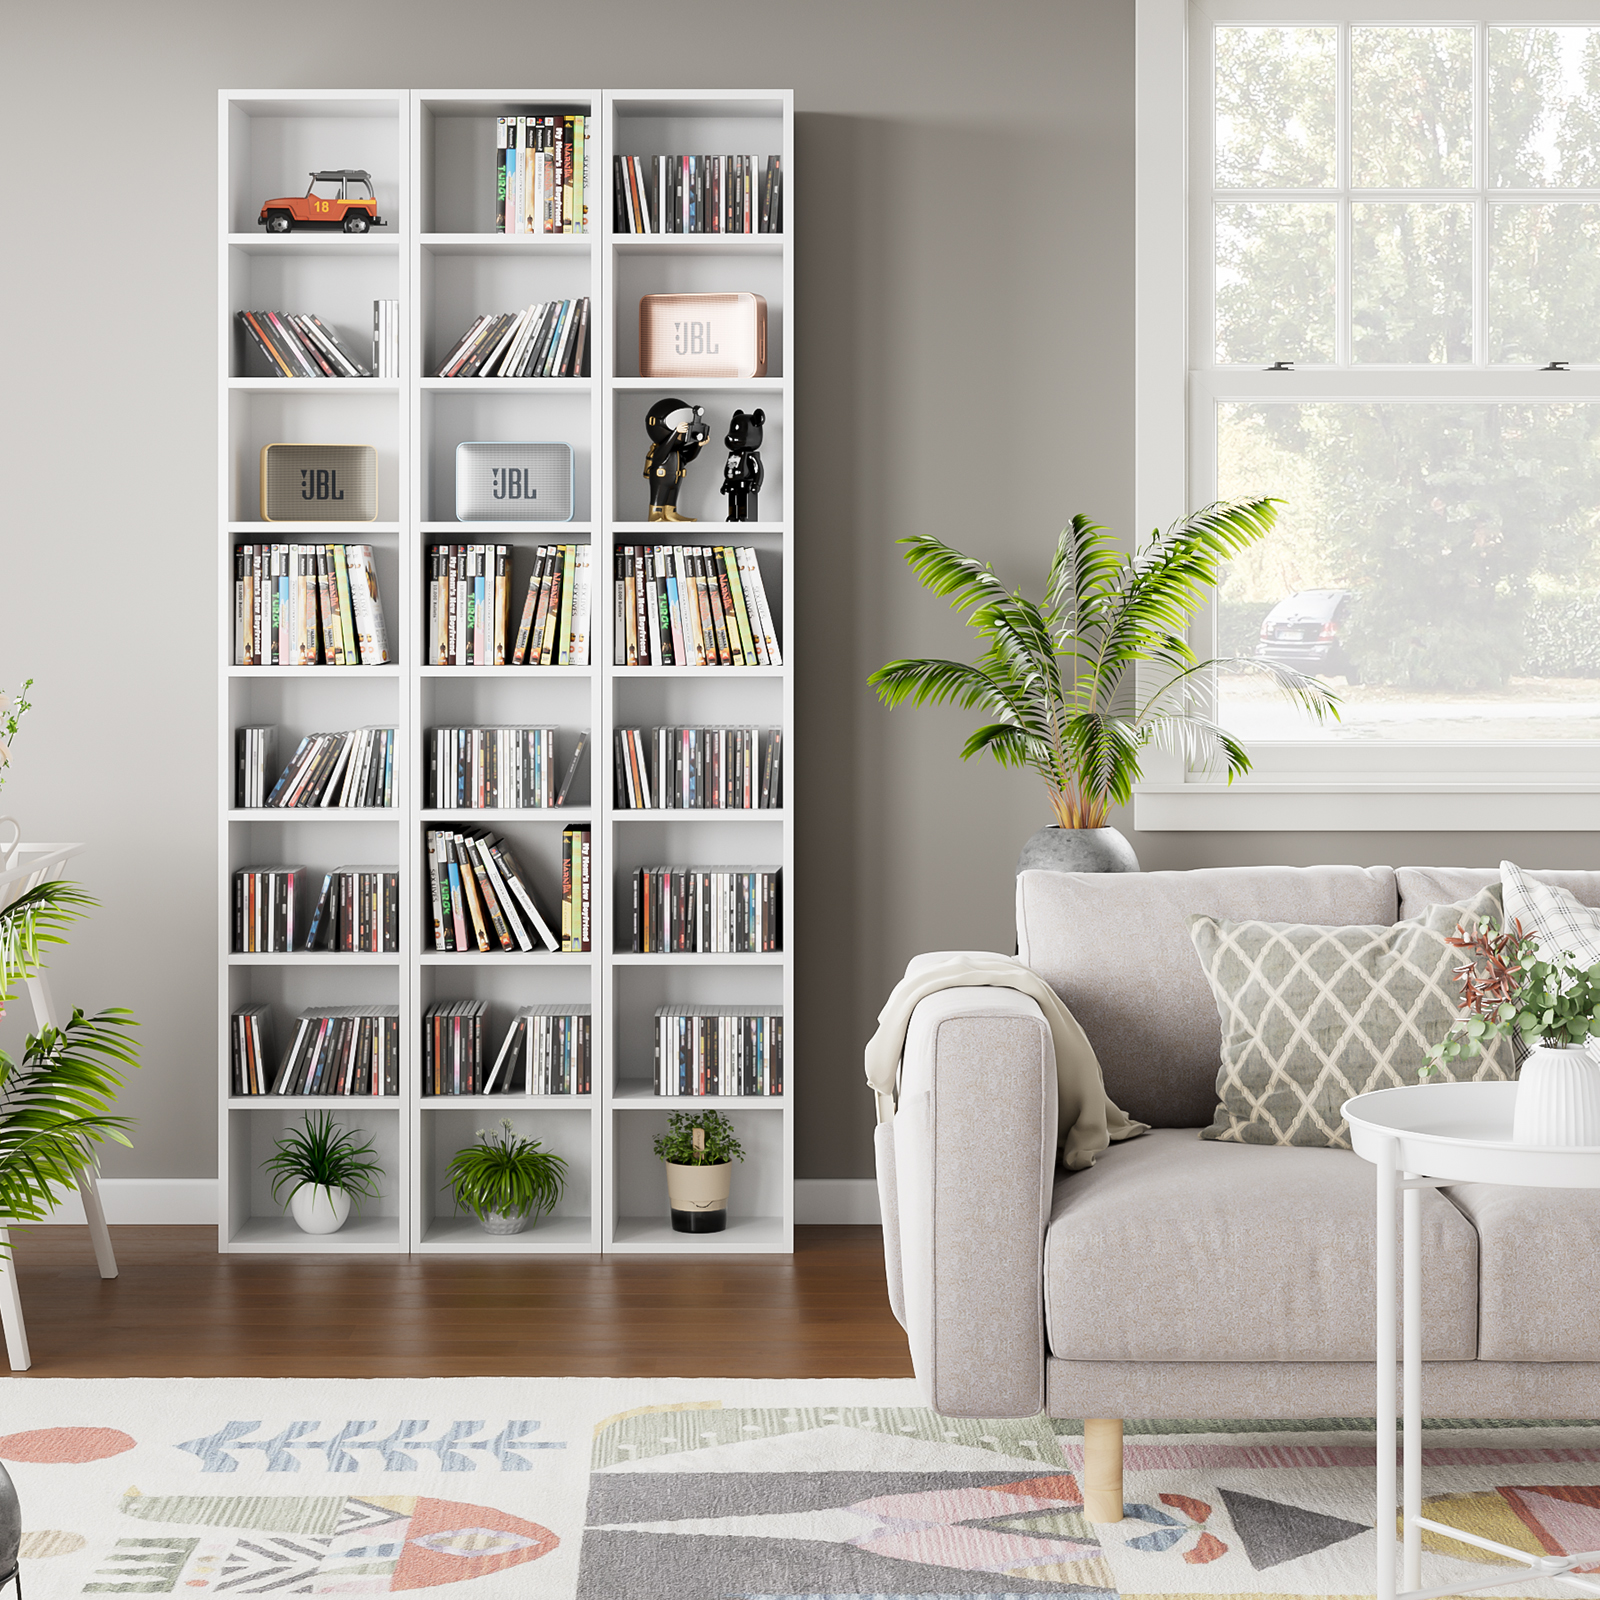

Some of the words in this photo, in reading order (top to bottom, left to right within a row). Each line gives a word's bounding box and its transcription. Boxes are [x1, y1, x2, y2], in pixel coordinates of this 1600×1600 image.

[554, 127, 563, 140] My
[555, 168, 563, 185] New
[313, 201, 330, 213] 18
[554, 186, 563, 227] Boyfriend
[674, 321, 720, 356] JBL
[300, 469, 344, 500] JBL
[492, 468, 537, 500] JBL
[253, 556, 261, 568] My
[448, 557, 456, 569] My
[635, 557, 643, 569] My
[253, 615, 261, 655] Boyfriend
[448, 616, 456, 656] Boyfriend
[638, 616, 648, 657] Boyfriend
[581, 842, 589, 855] My
[581, 902, 589, 942] Boyfriend
